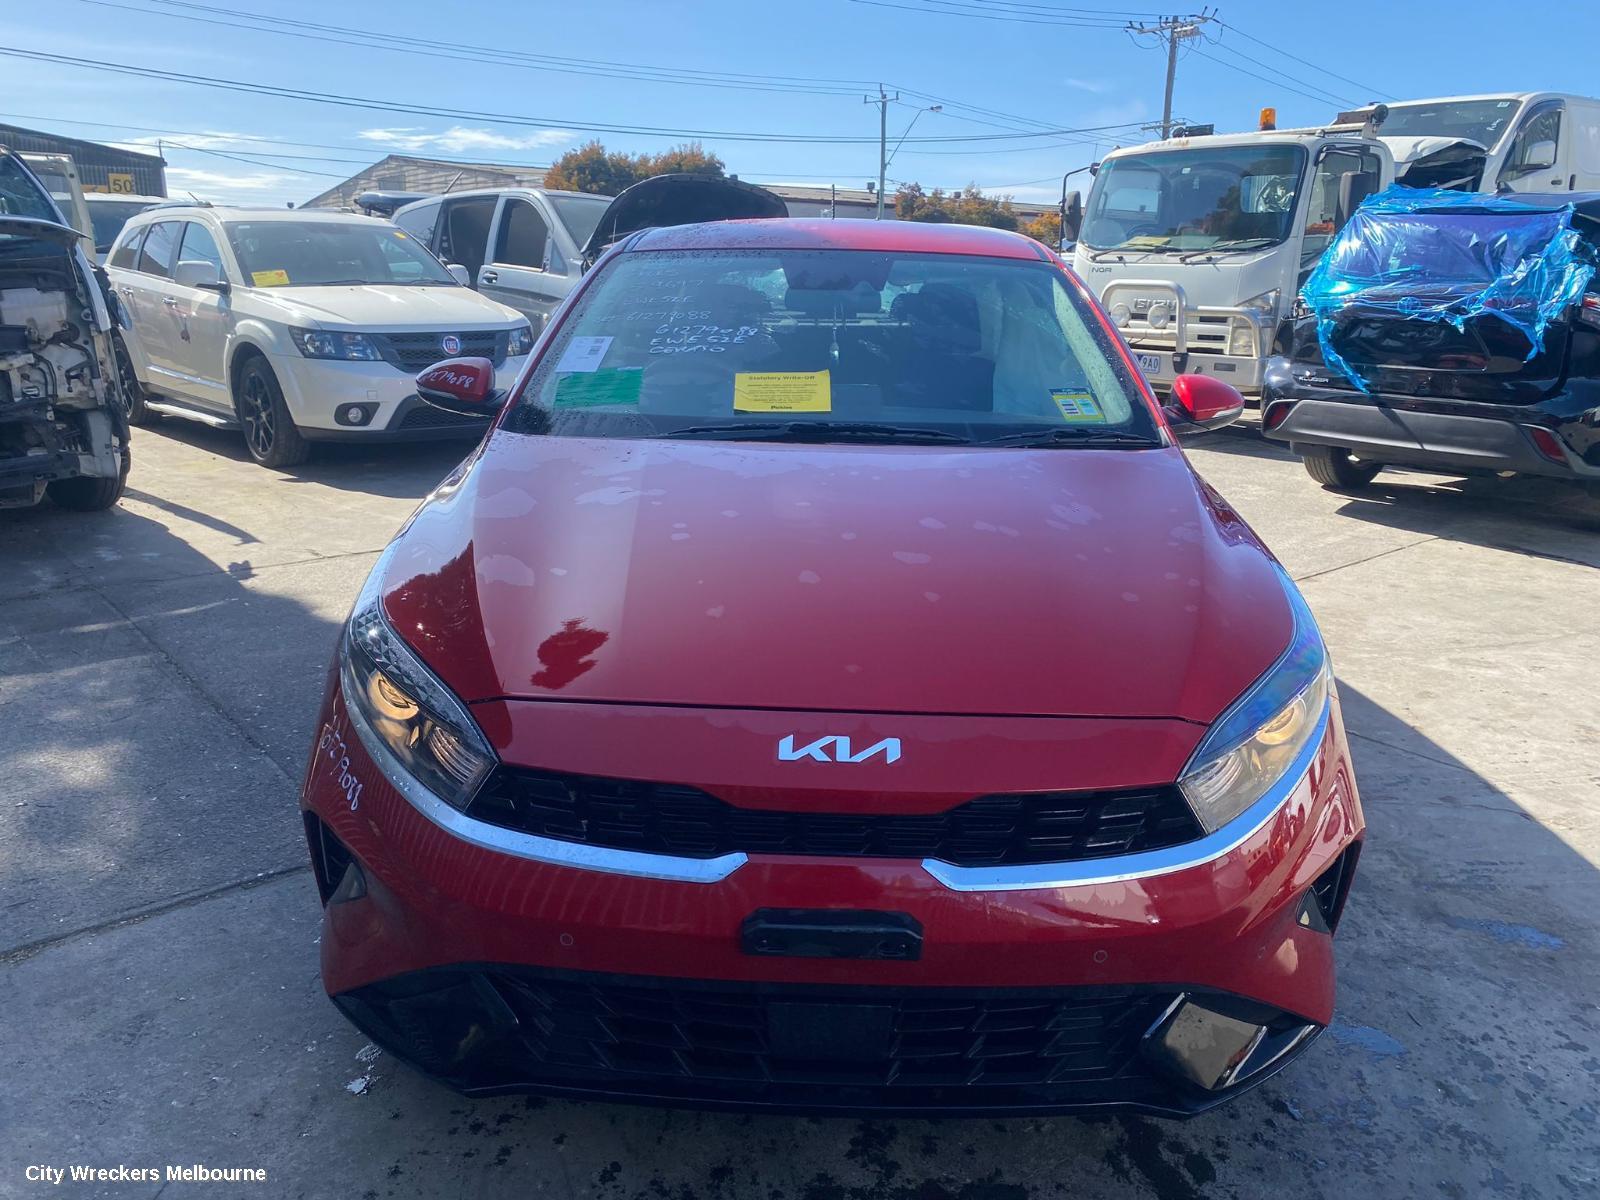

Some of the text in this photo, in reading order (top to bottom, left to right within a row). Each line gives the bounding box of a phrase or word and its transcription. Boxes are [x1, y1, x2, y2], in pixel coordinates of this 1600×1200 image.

[112, 178, 132, 193] 50
[655, 324, 759, 336] 61279088
[778, 734, 902, 764] KIA
